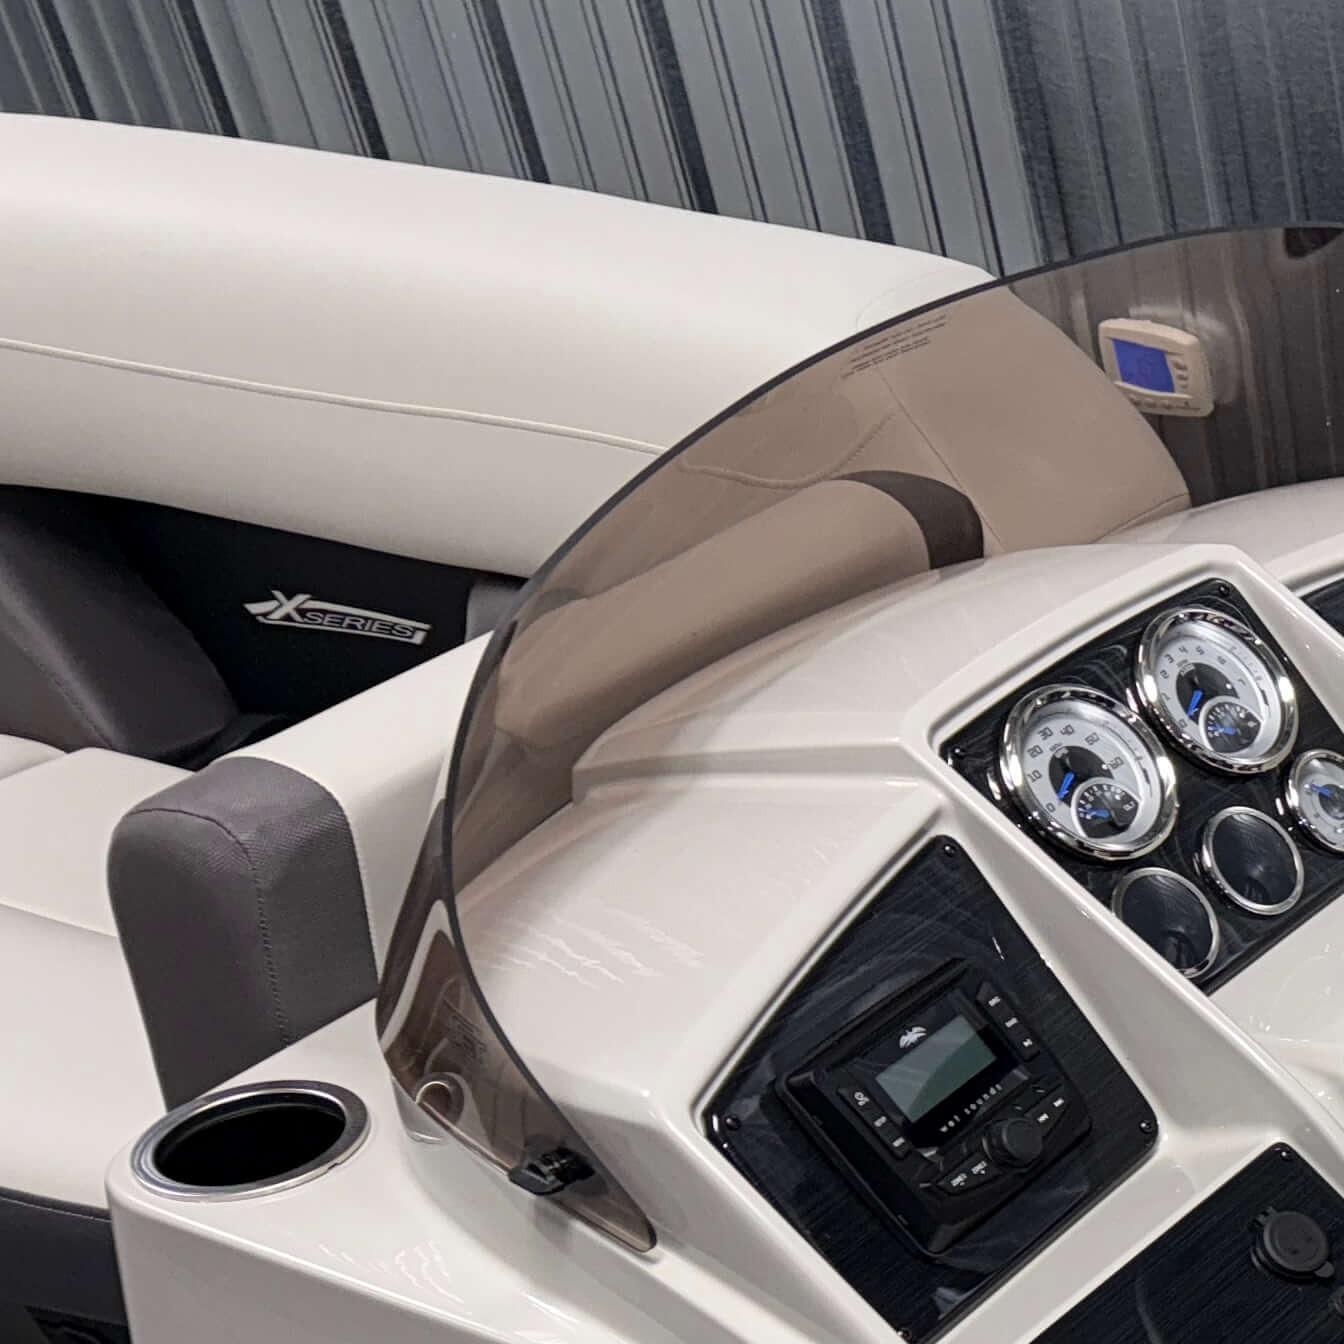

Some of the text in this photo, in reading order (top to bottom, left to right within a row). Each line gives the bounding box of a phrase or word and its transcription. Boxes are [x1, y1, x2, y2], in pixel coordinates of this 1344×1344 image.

[1038, 726, 1054, 741] 30
[1060, 724, 1075, 737] 40
[1027, 744, 1044, 759] 20
[1027, 769, 1042, 783] 10
[963, 1084, 1003, 1115] sounds
